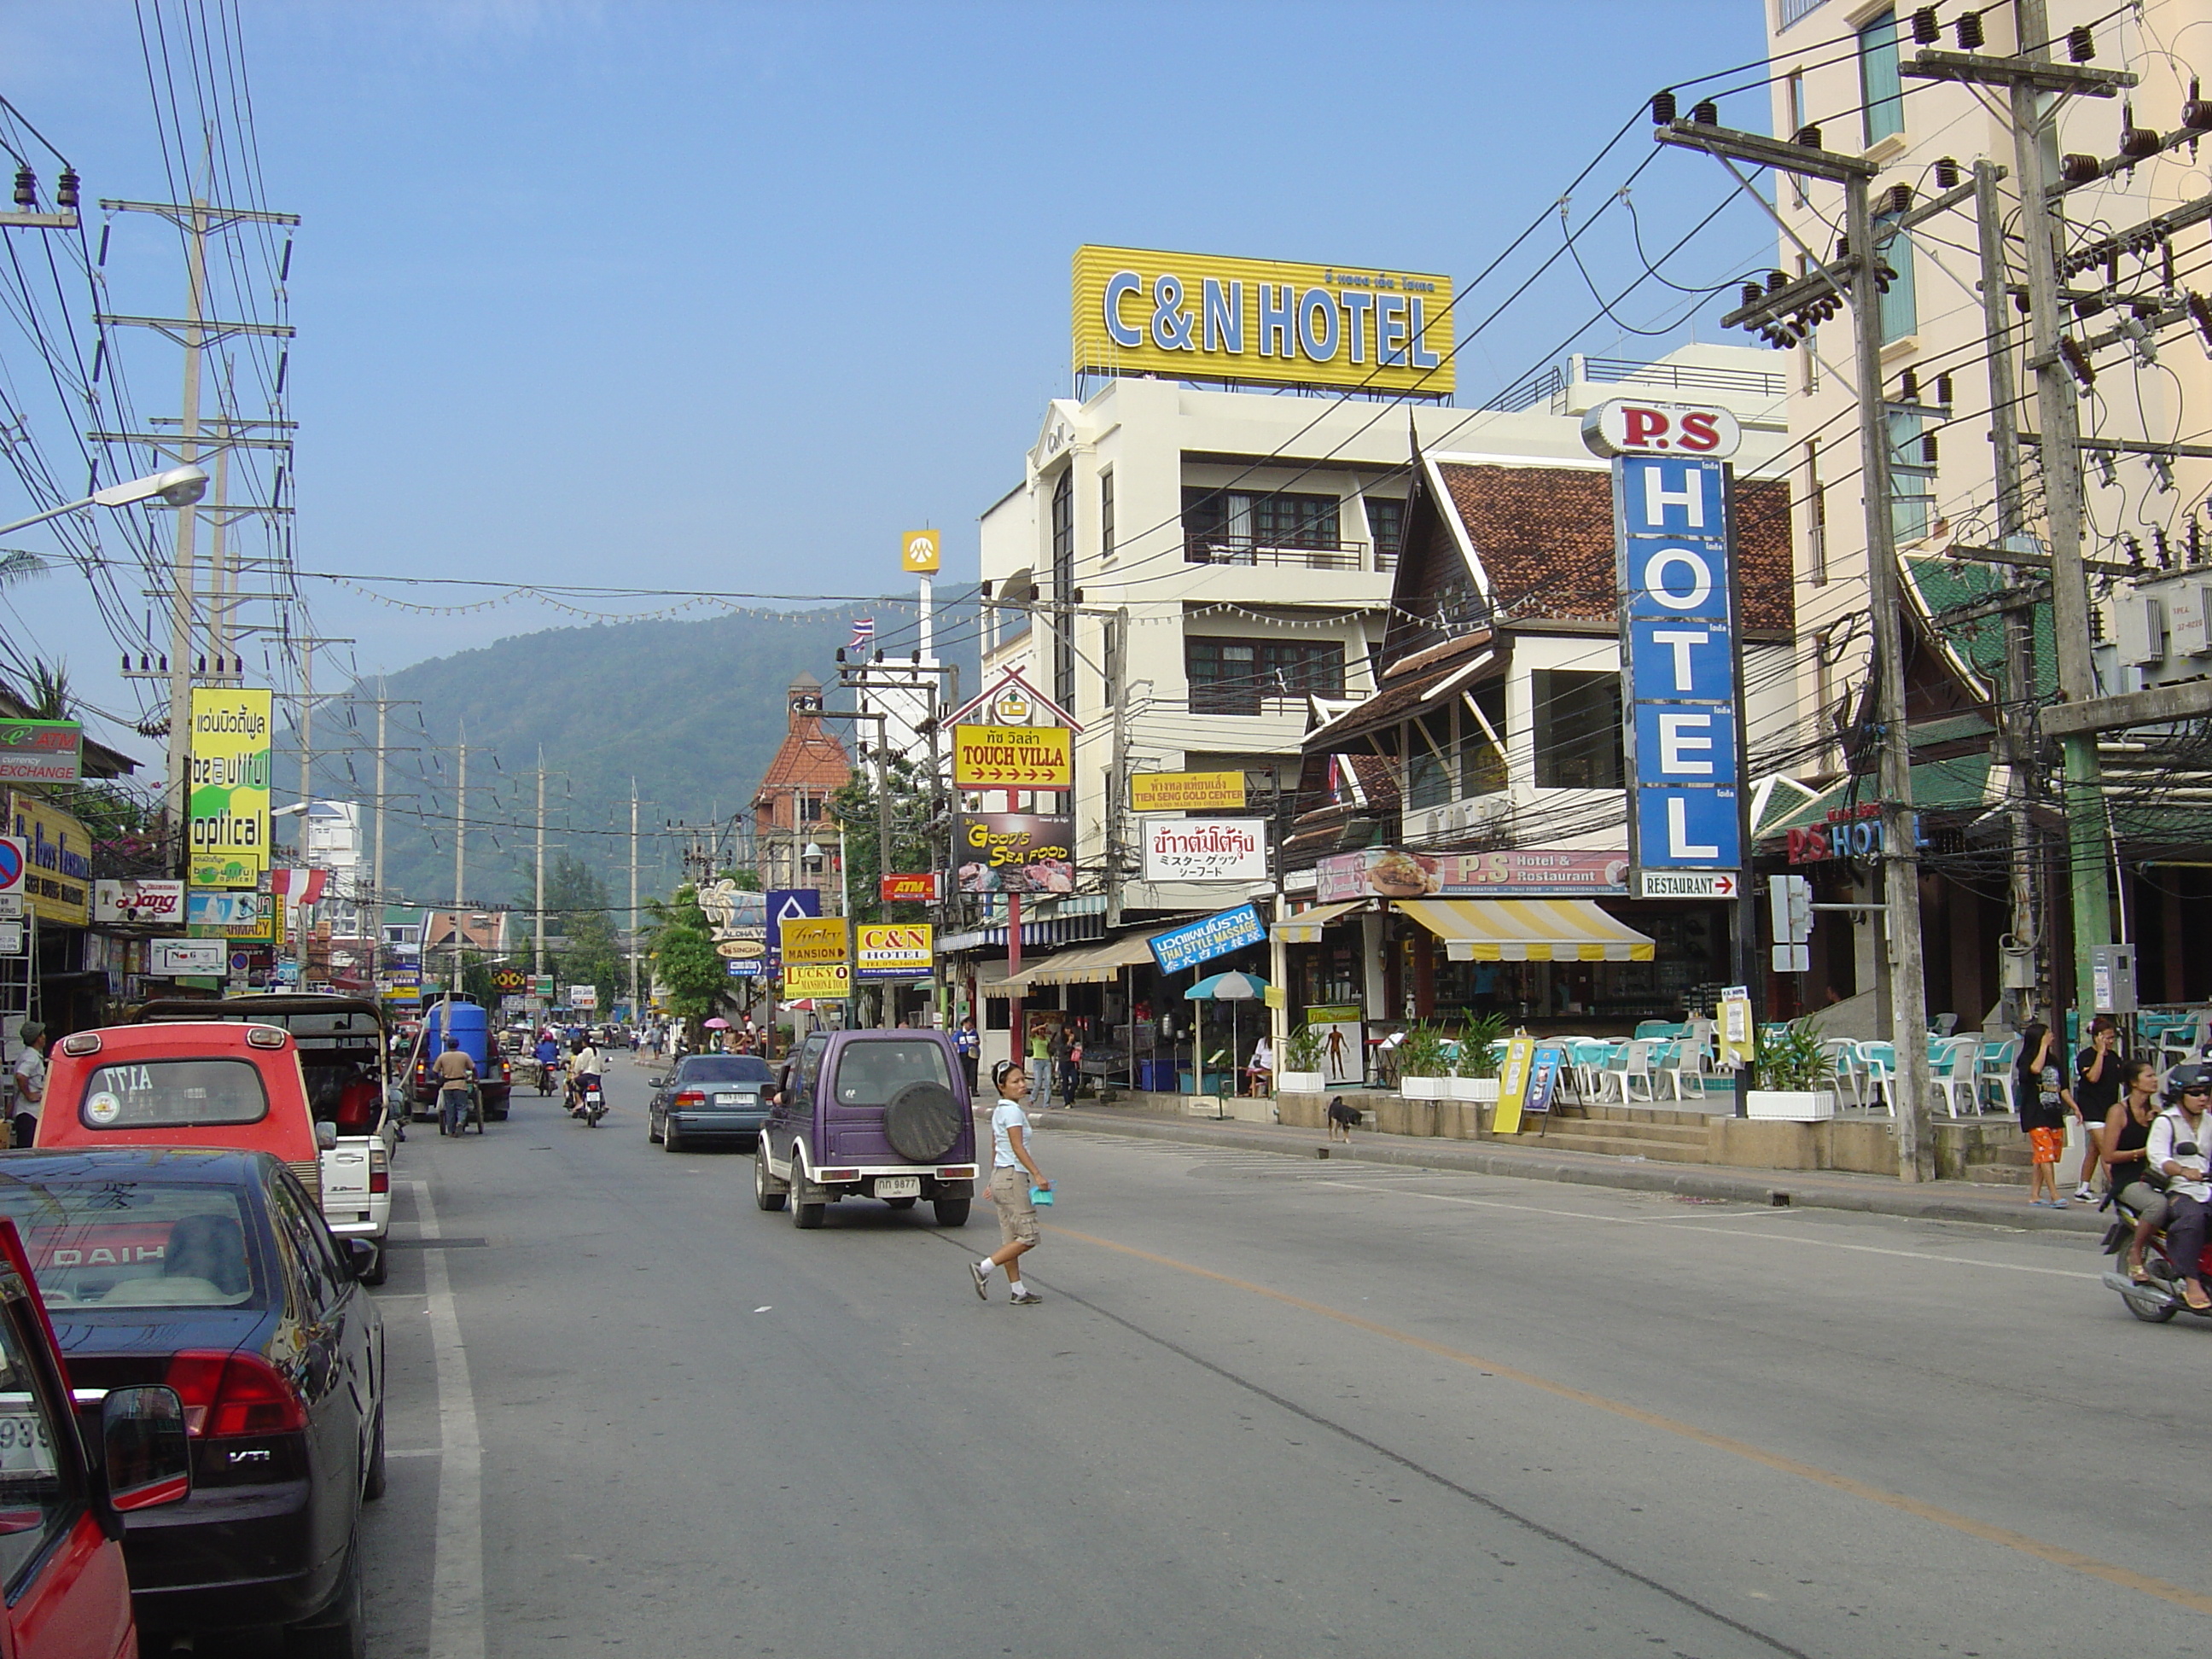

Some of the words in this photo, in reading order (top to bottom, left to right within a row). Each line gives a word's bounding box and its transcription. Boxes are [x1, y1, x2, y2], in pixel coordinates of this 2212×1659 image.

[1103, 270, 1244, 354] C&N
[1259, 282, 1441, 370] HOTEL
[1621, 406, 1721, 451] P.S
[1644, 466, 1719, 859] HOTEL
[35, 732, 77, 748] ATM
[1008, 731, 1040, 745] วิลล่า
[2, 756, 41, 765] currency
[963, 745, 1016, 765] TOUCH
[1018, 747, 1065, 766] VILLA
[0, 764, 76, 779] EXCHANGE
[1135, 793, 1155, 802] TIEN
[1157, 792, 1181, 801] SENG
[1183, 791, 1207, 800] GOLD
[1208, 789, 1243, 800] CENTER
[194, 809, 261, 853] optical
[1831, 814, 1930, 858] HOTL
[1154, 825, 1254, 860] ข้าวต้มโต้รุ่ง
[989, 845, 1024, 867] SEA
[1028, 845, 1068, 863] FOOD
[1516, 855, 1554, 867] Hotel
[1559, 855, 1570, 866] &
[1179, 866, 1223, 877] シーフード
[1458, 853, 1510, 884] P.S
[894, 881, 926, 893] ATM
[1646, 877, 1714, 894] RESTAURANT
[225, 922, 270, 936] ARMACY
[722, 929, 754, 938] ALOHA
[864, 929, 927, 949] C&N
[1161, 946, 1184, 963] THAI
[1184, 934, 1214, 954] STYLE
[1214, 919, 1259, 943] MASSAGE
[789, 948, 835, 959] MANSION
[867, 951, 924, 959] HOTEL
[786, 967, 832, 985] LUCKY
[894, 1179, 916, 1189] 9877
[54, 1245, 165, 1266] DAIH
